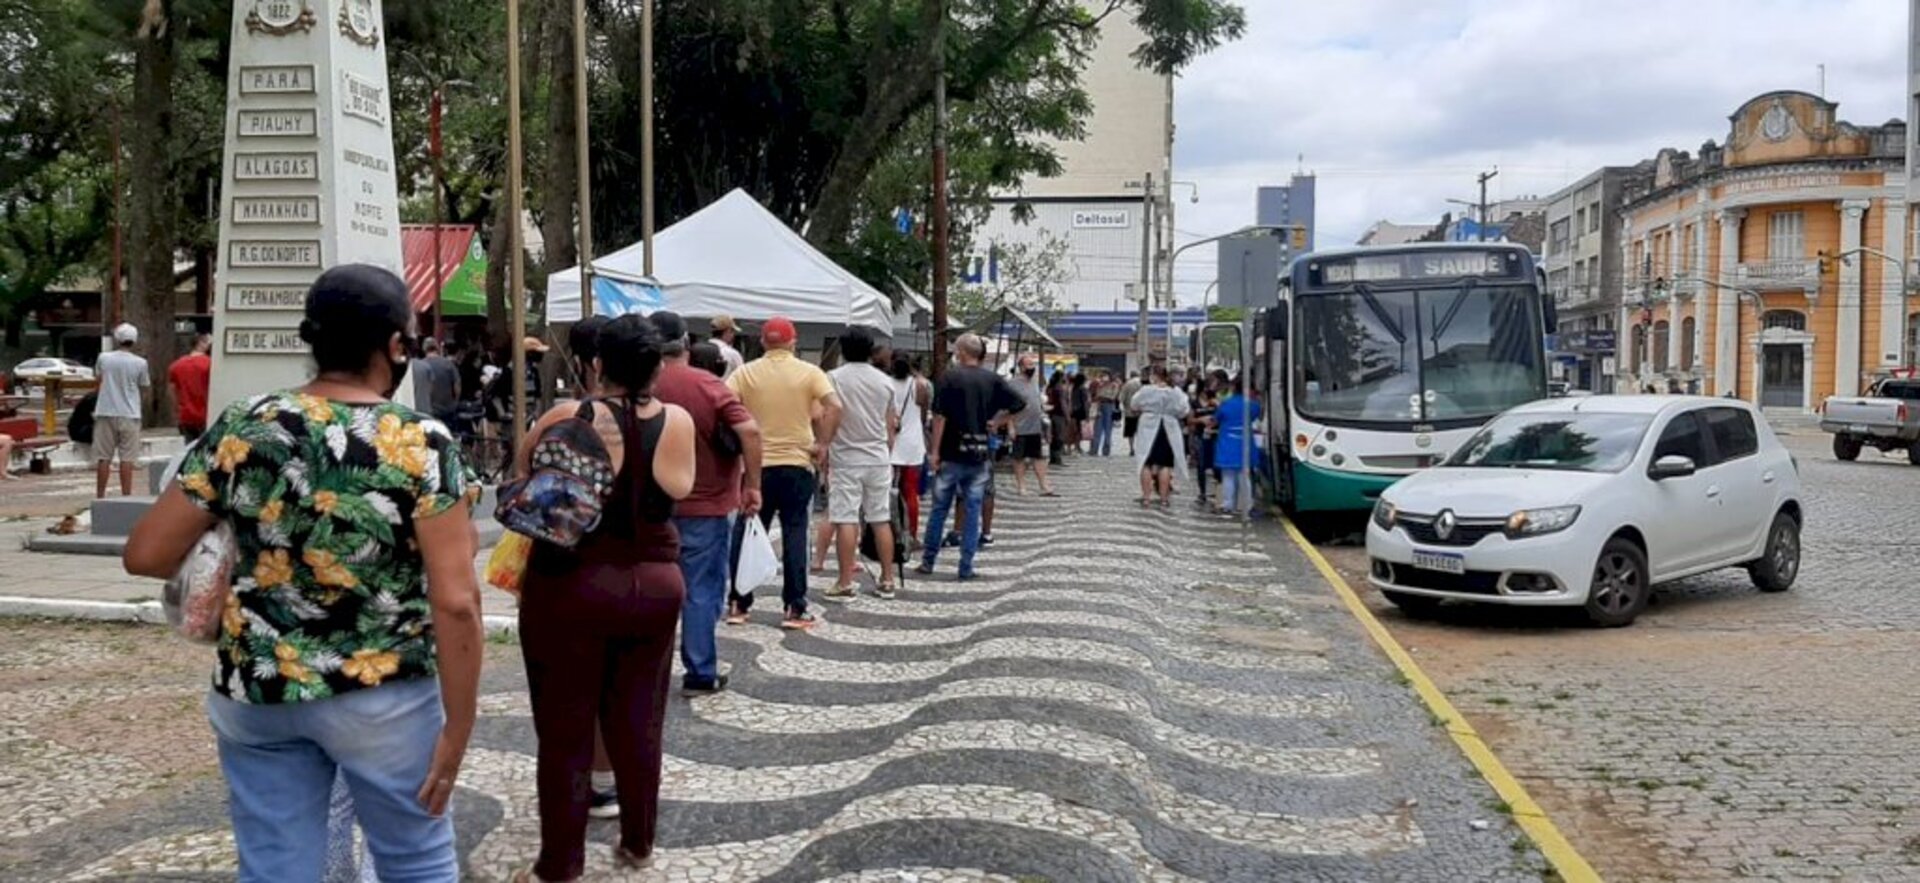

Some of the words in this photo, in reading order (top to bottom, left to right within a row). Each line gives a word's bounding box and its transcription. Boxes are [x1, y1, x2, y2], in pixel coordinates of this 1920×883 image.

[252, 116, 302, 131] PIAUHY
[244, 157, 308, 175] ALAGOAS
[1075, 212, 1125, 225] Deltasul
[241, 289, 308, 306] PERNAMBUC
[233, 333, 250, 349] RIO
[253, 333, 267, 348] DE
